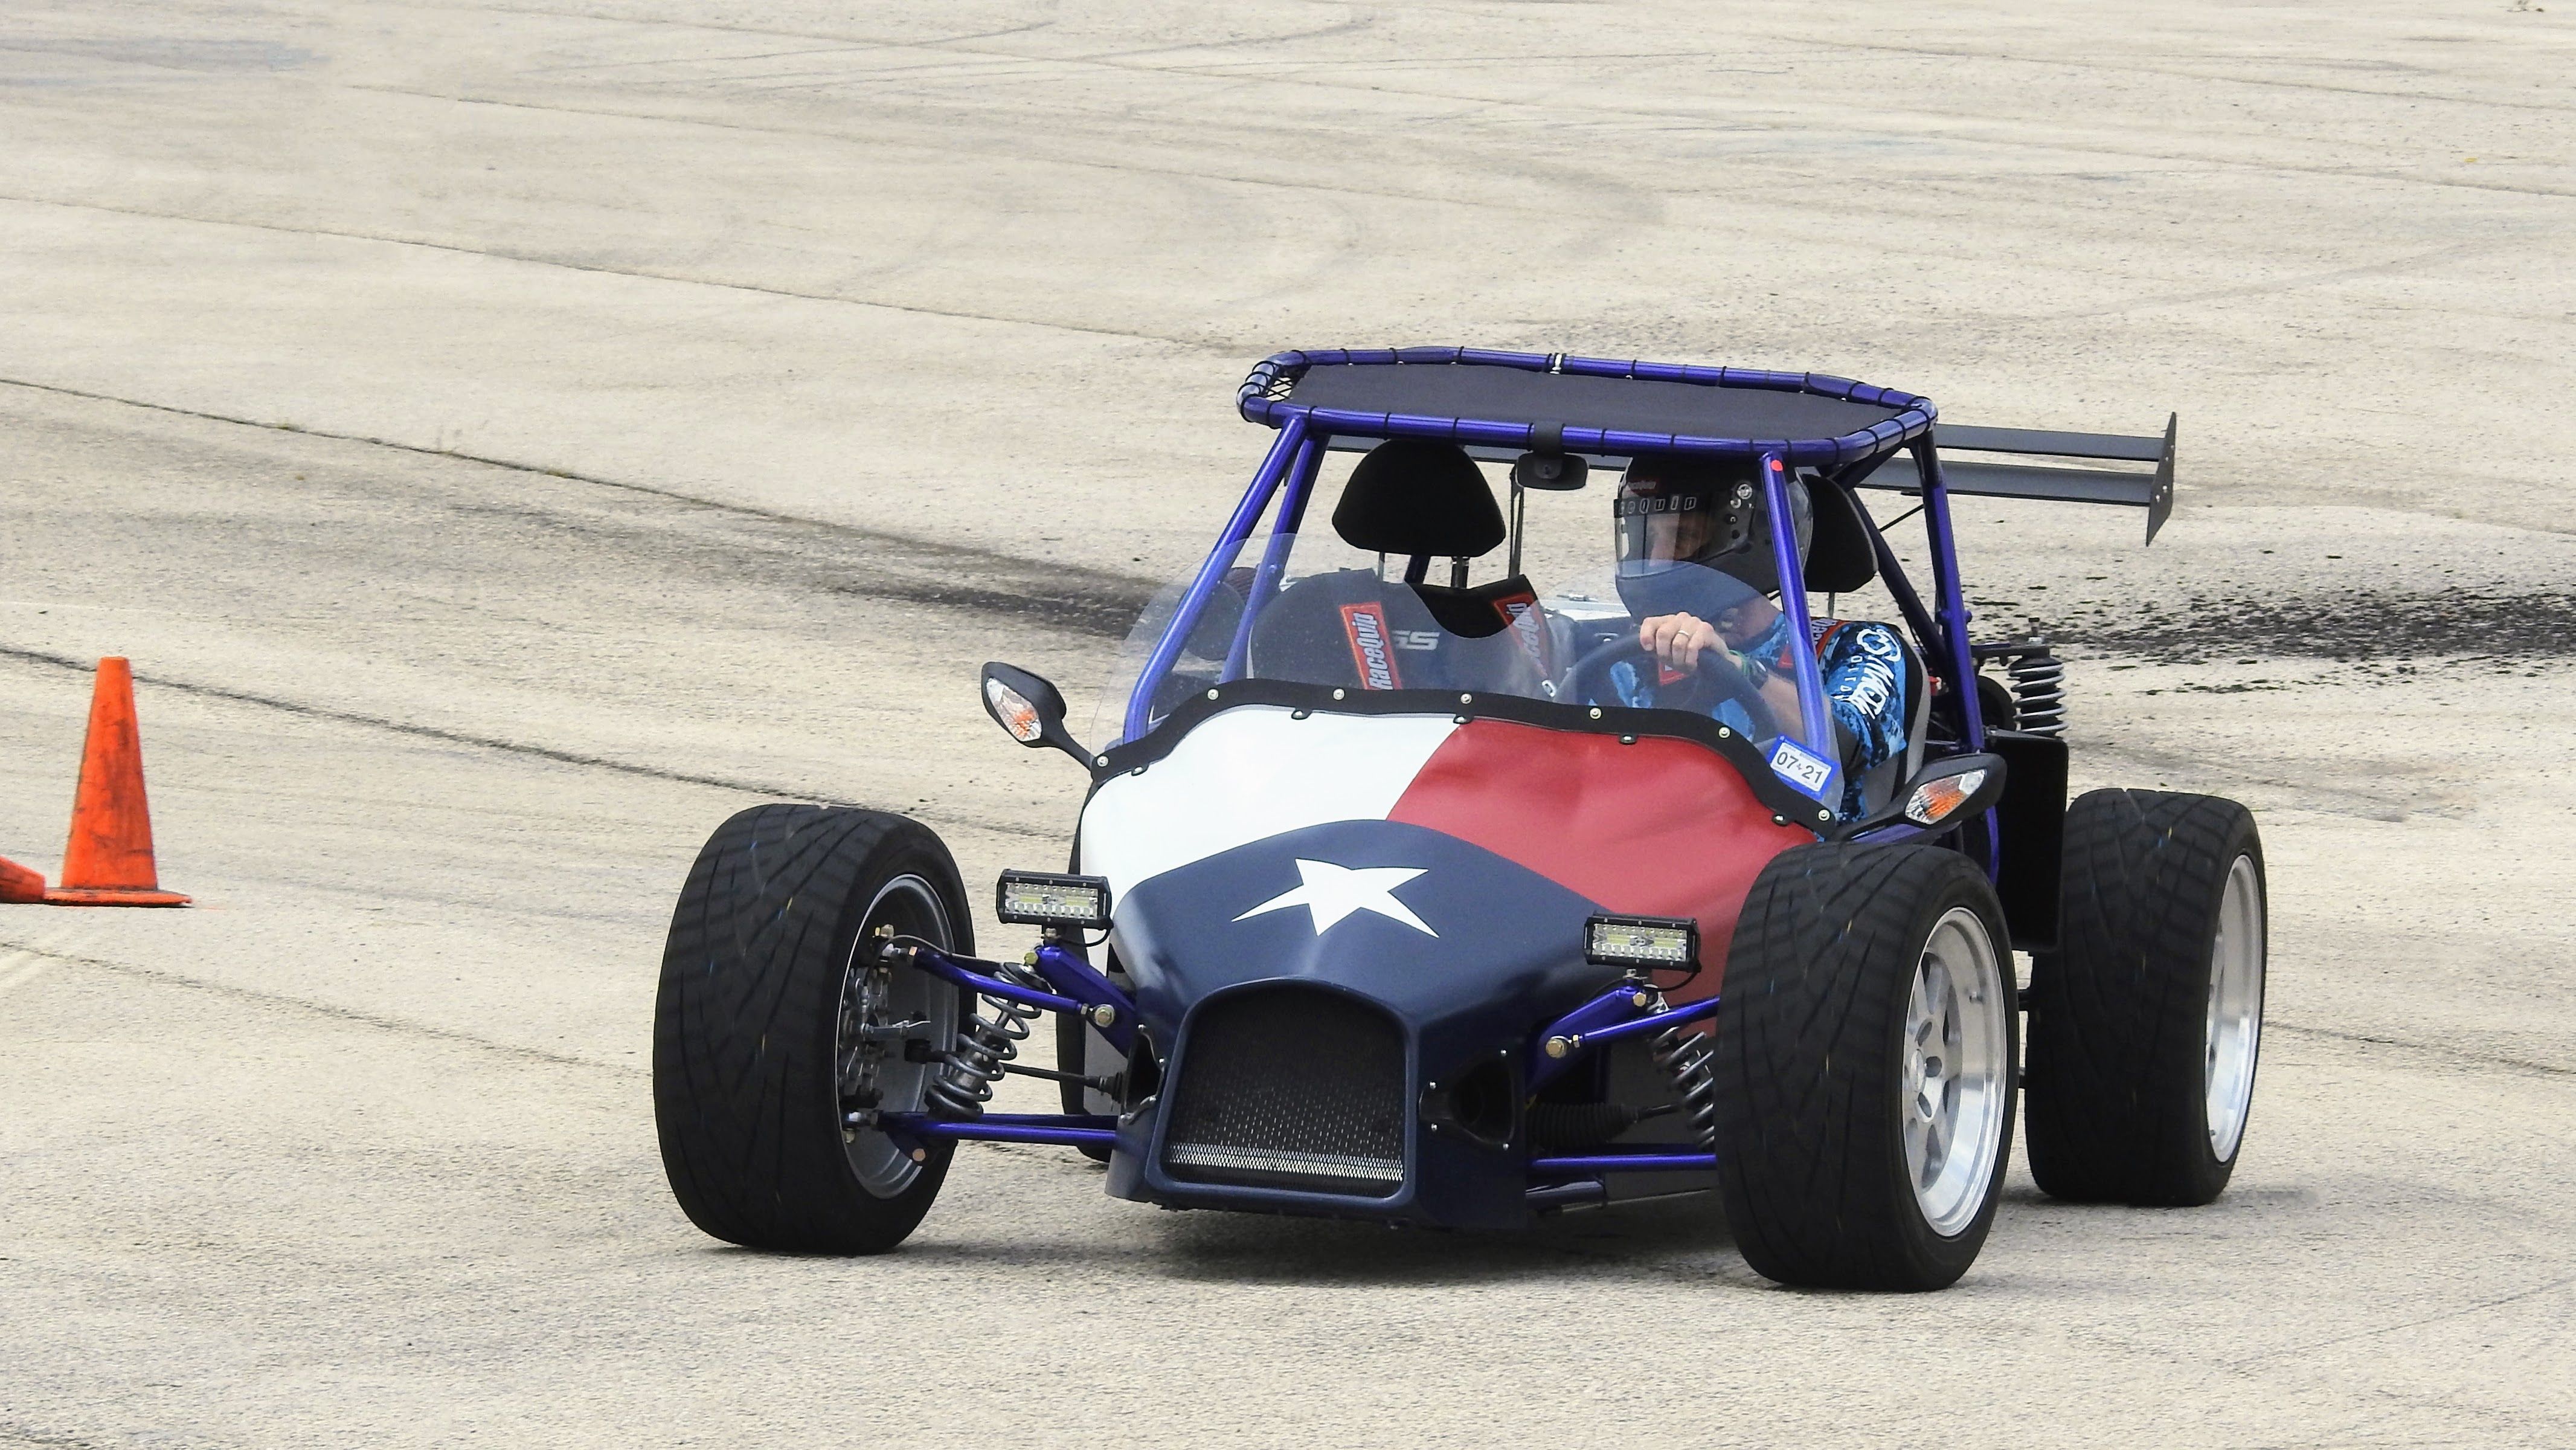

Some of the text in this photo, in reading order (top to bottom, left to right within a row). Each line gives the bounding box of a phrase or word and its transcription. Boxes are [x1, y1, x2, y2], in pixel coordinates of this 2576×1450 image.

[1352, 611, 1394, 690] RaceQuip
[1776, 751, 1799, 769] 07
[1801, 765, 1823, 784] 21
